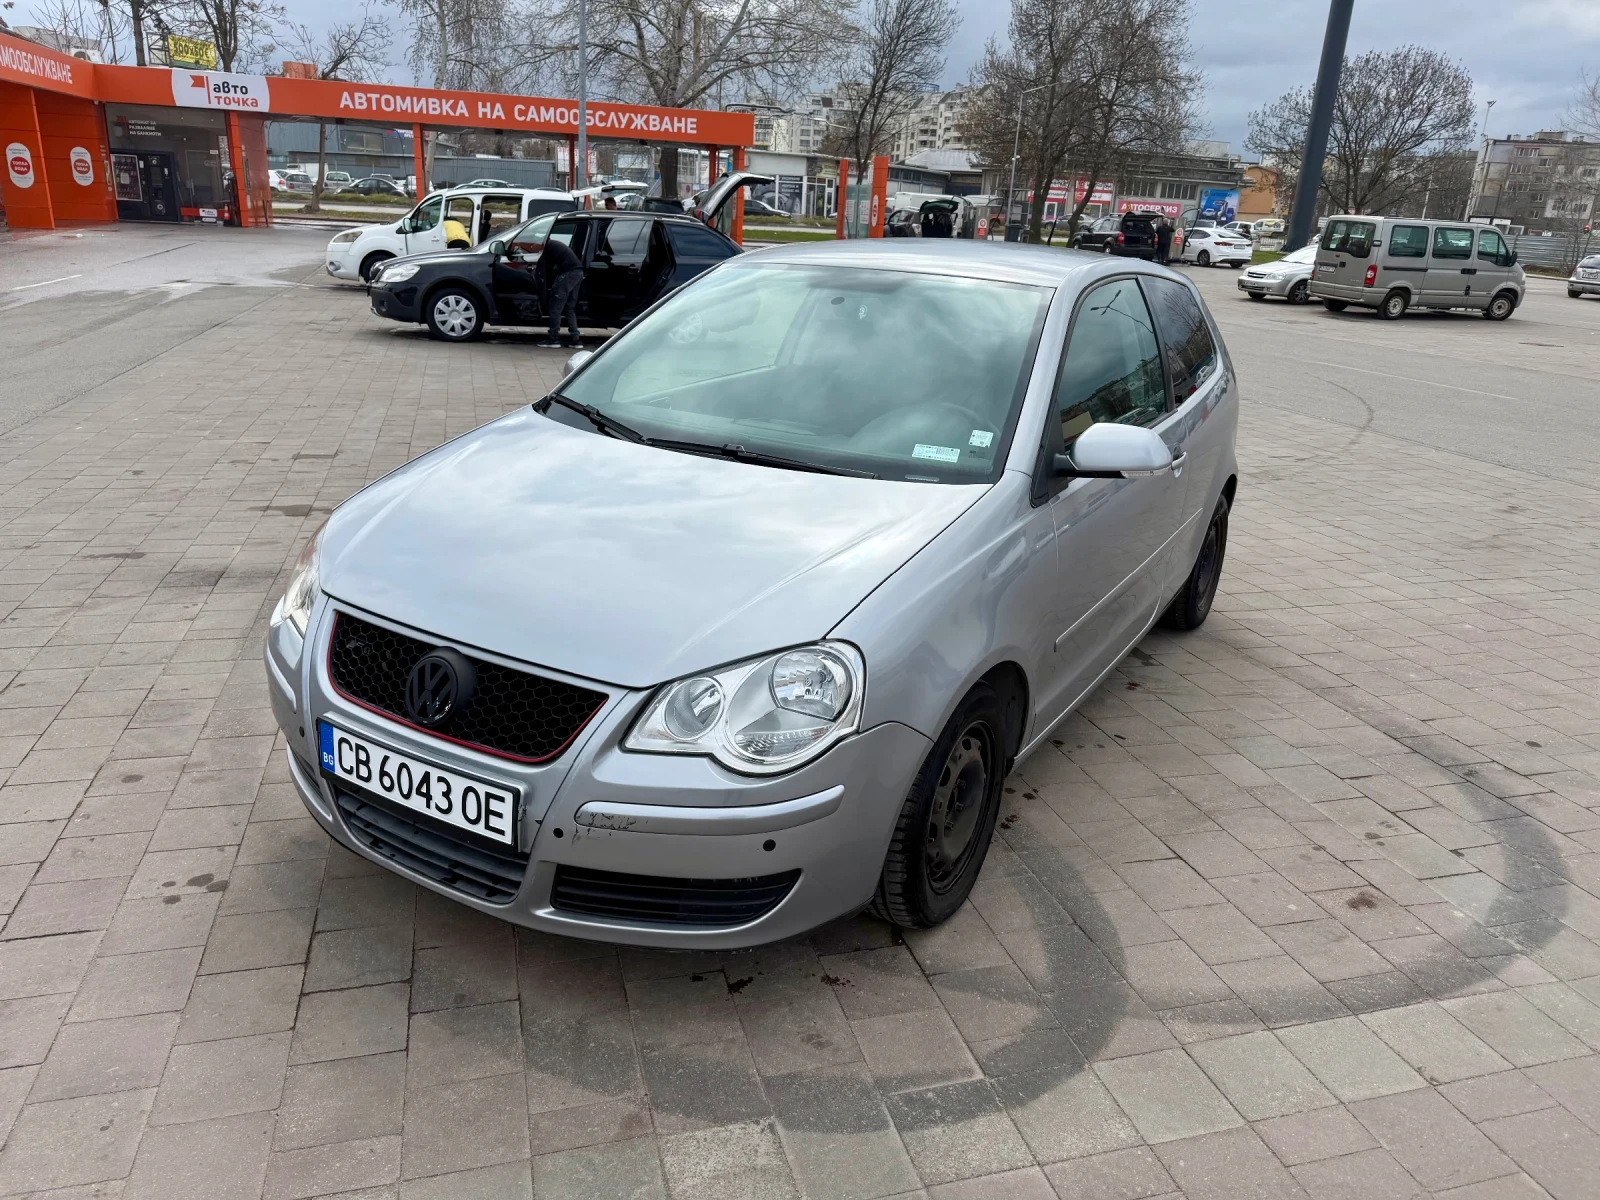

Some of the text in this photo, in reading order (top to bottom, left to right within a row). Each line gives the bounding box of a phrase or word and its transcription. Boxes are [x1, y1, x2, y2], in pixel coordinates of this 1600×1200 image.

[213, 81, 249, 95] авто
[214, 95, 259, 107] точка
[339, 90, 698, 135] АВТОМИВКА НА САМООБСЛУЖВАНЕ
[322, 751, 335, 767] BG
[337, 735, 508, 837] CB 6043 OE
